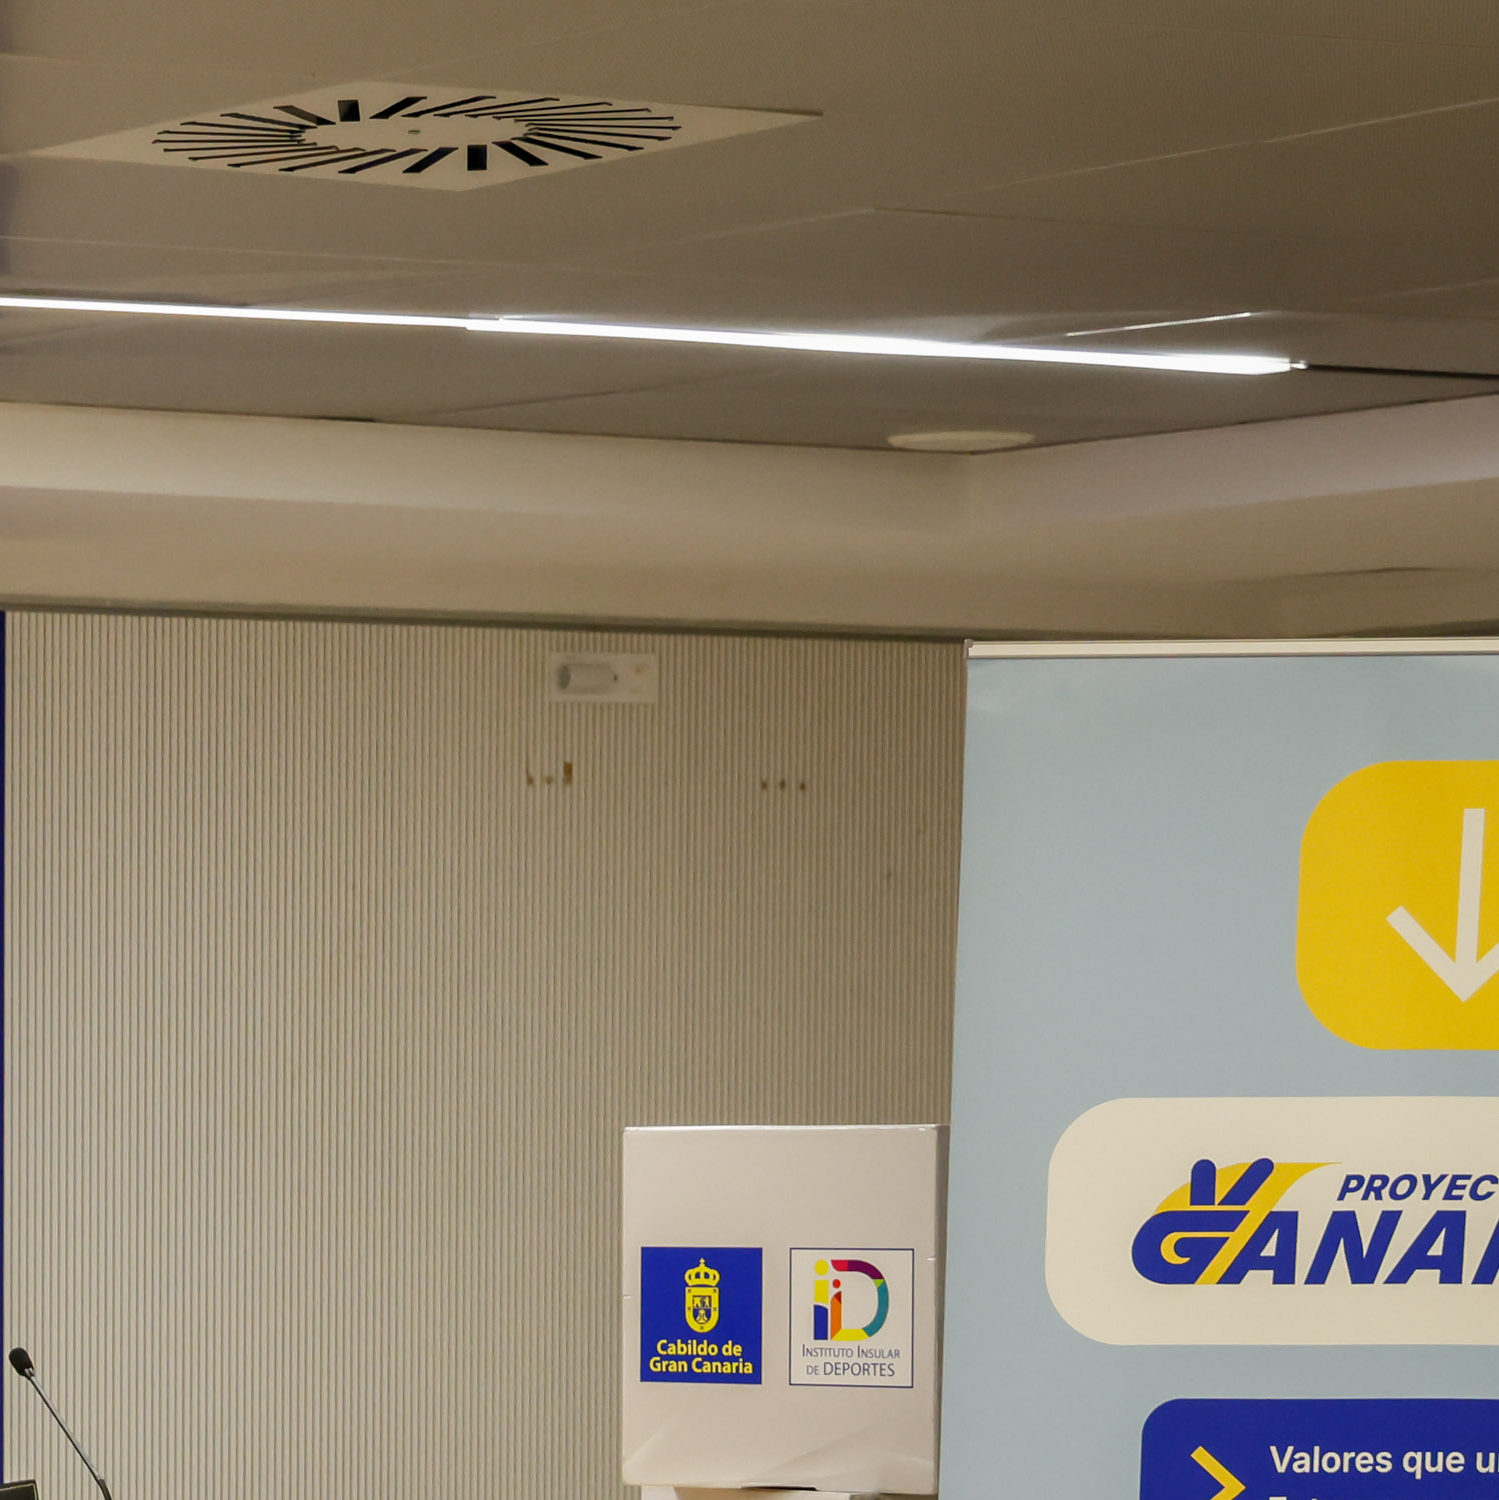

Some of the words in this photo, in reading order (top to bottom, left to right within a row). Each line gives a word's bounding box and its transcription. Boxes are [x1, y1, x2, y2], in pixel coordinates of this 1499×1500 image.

[656, 1339, 718, 1357] Cabildo
[722, 1340, 742, 1356] de
[649, 1357, 688, 1374] Gran
[691, 1357, 753, 1374] Canaria
[823, 1362, 895, 1377] DEPORTES
[1269, 1445, 1393, 1473] Valores
[1402, 1451, 1465, 1480] que
[1476, 1452, 1499, 1473] u
